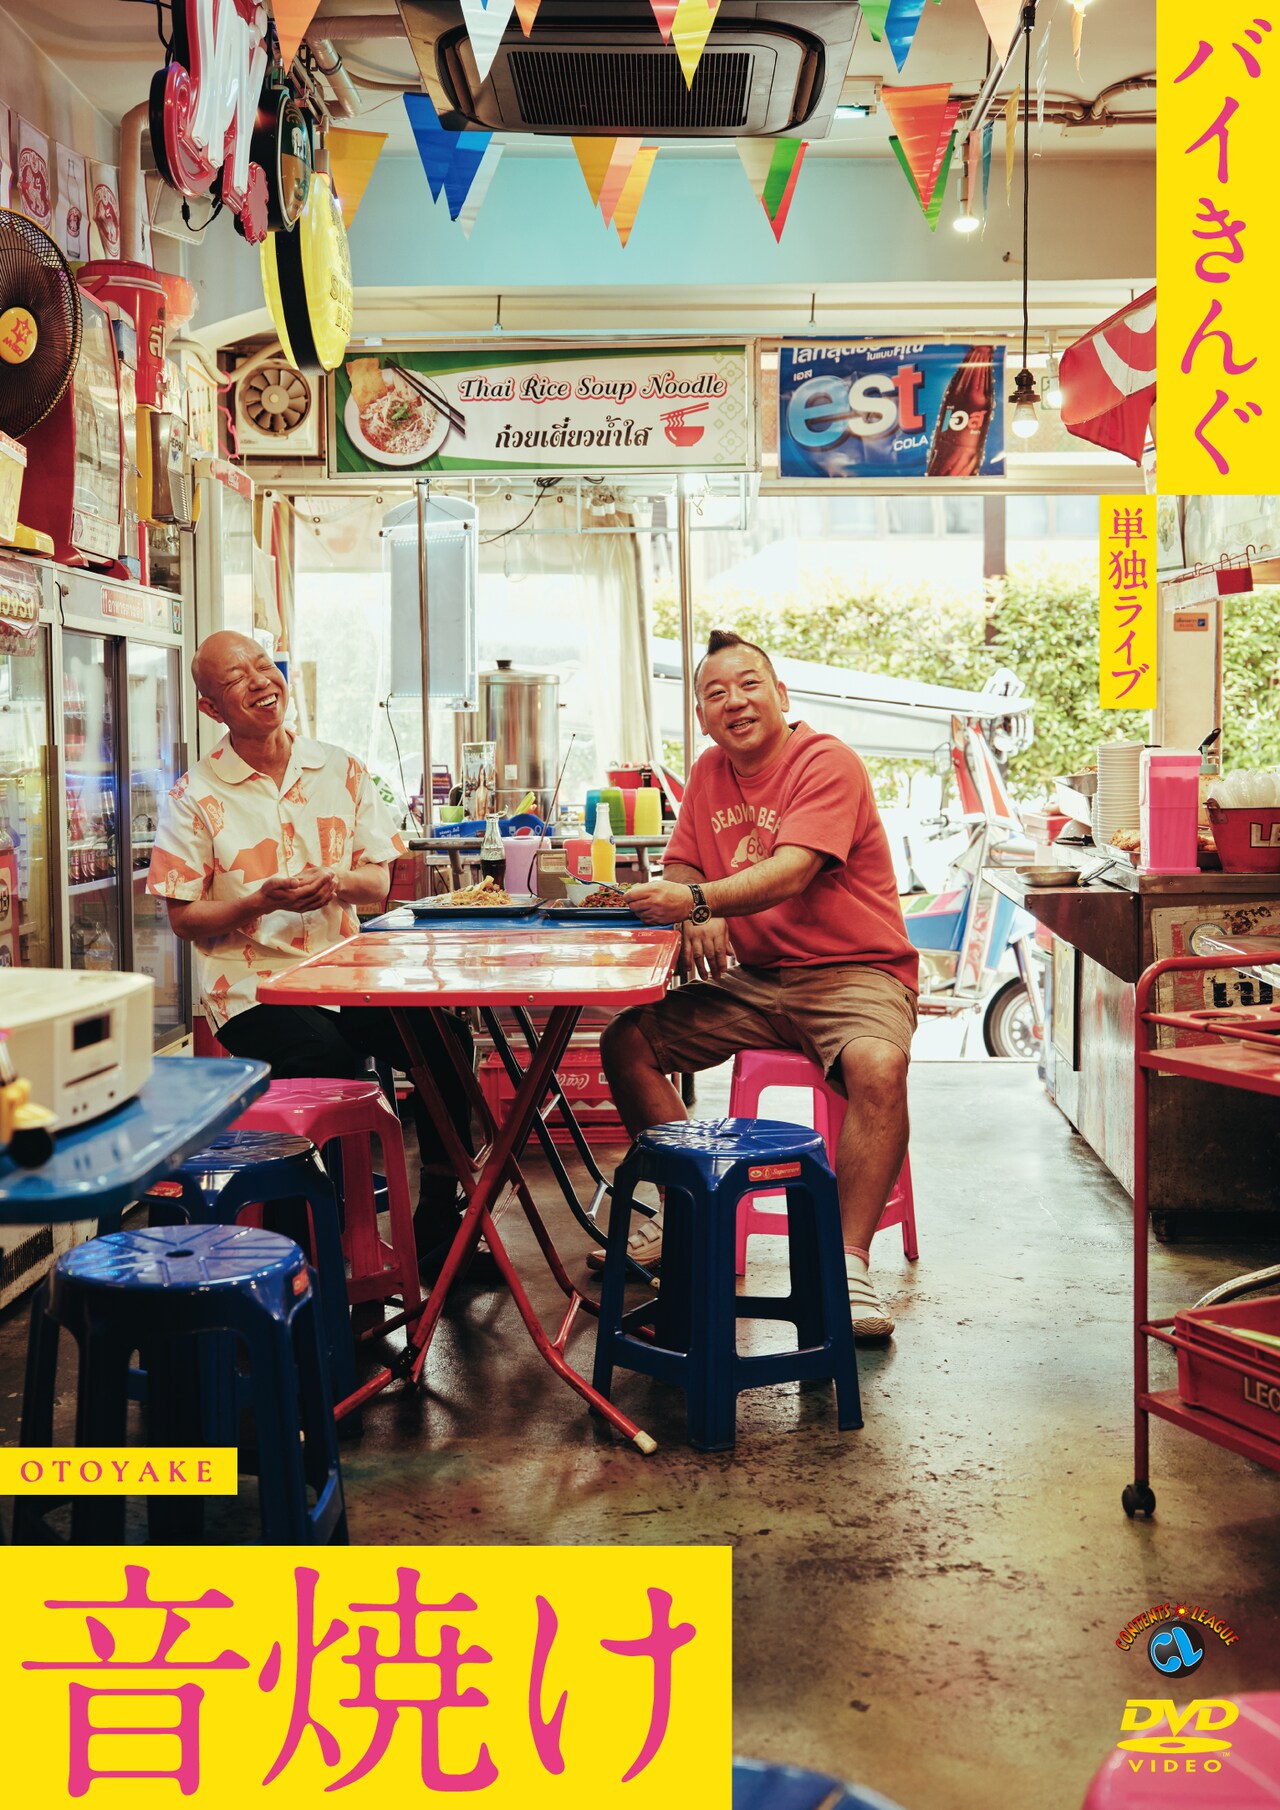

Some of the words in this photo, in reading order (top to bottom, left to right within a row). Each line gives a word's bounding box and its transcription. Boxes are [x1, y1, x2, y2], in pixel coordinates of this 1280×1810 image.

[459, 376, 514, 400] Thai
[521, 375, 570, 402] Rice
[577, 375, 634, 402] Soup
[641, 371, 726, 397] Noodle
[786, 364, 927, 450] est
[495, 415, 653, 448] ก๋วยเตี๋ยวน้ำใส
[893, 435, 929, 452] COLA
[1244, 1376, 1280, 1412] LEO
